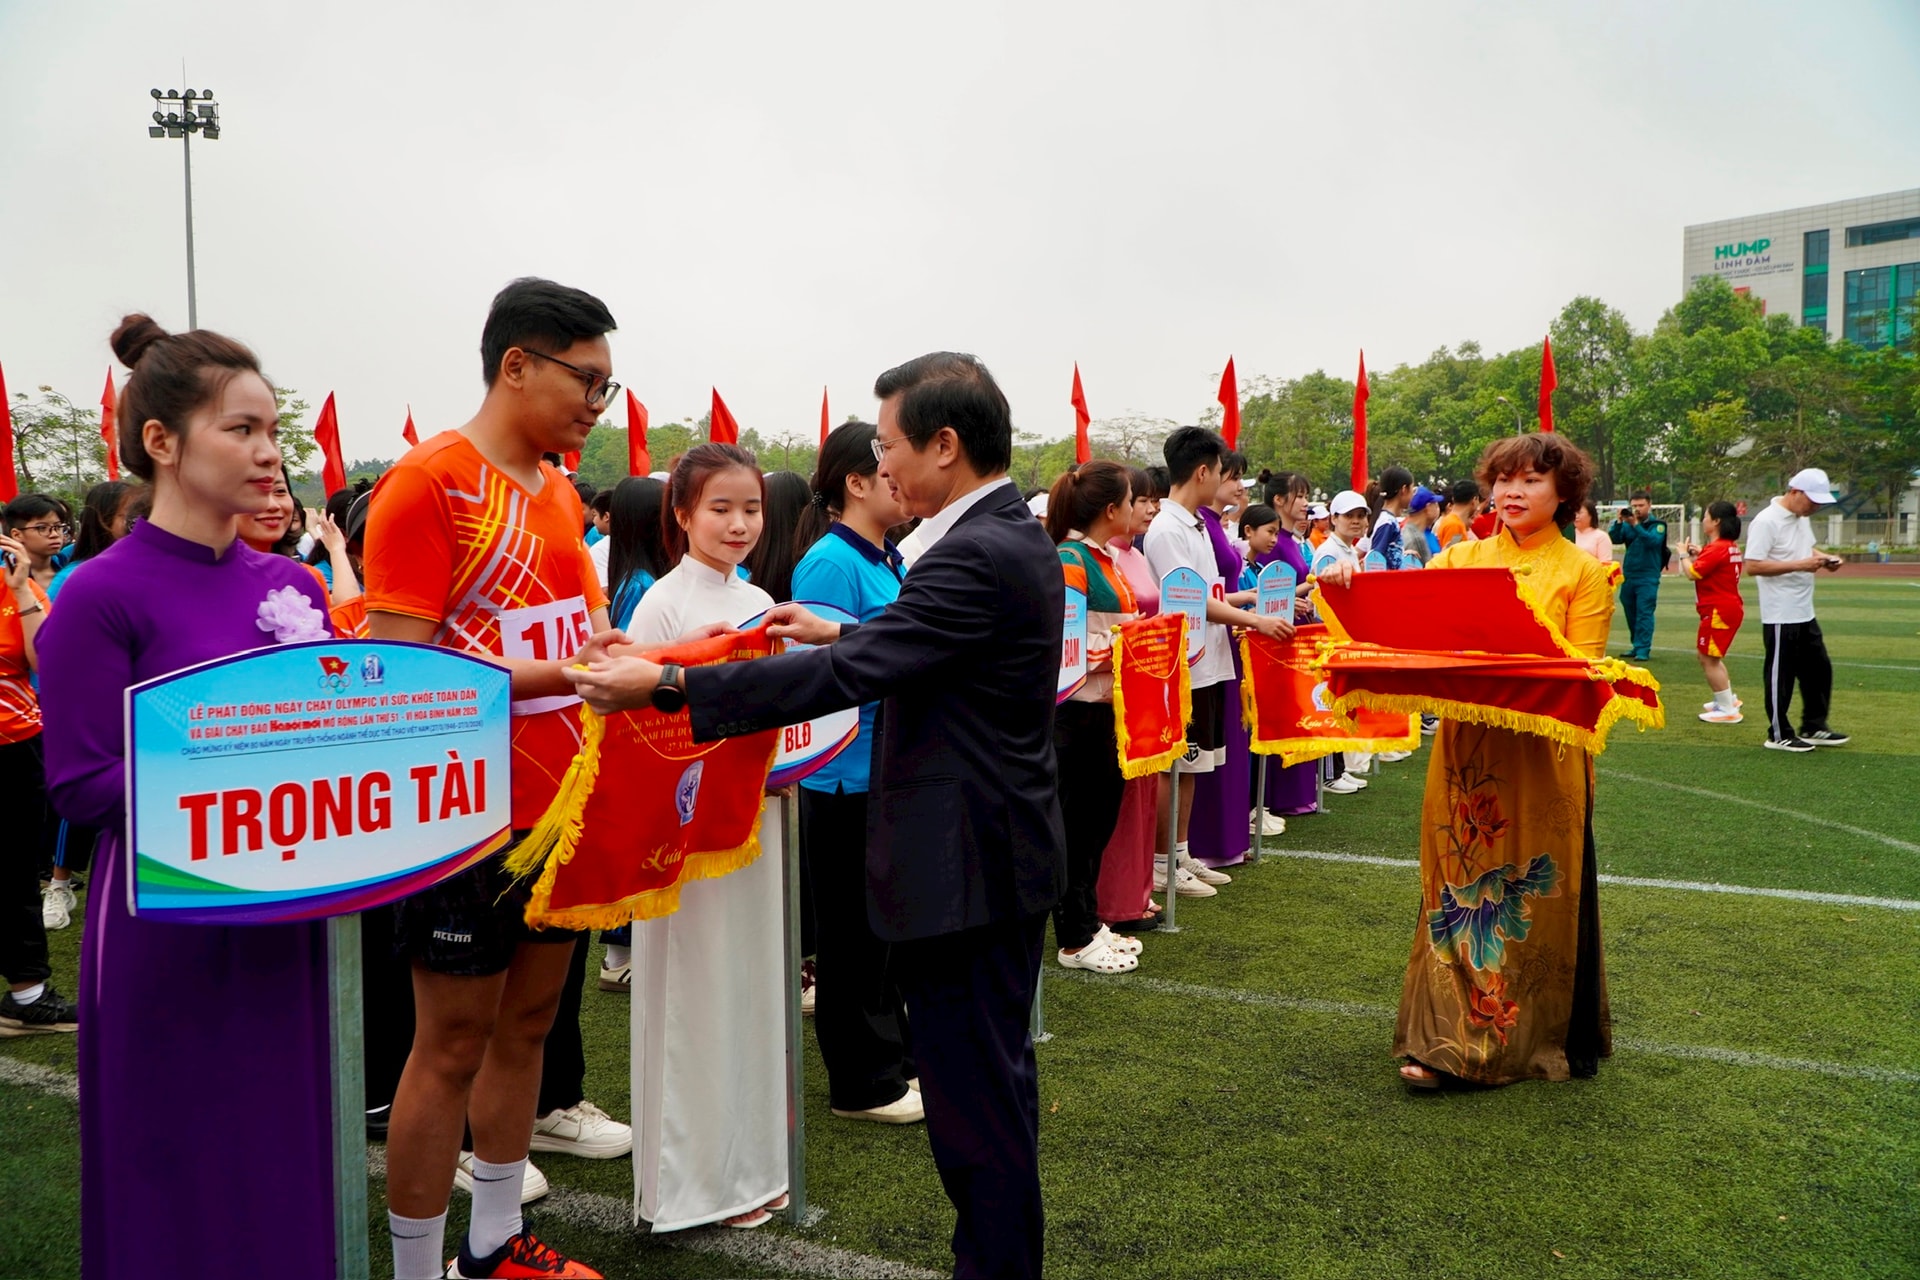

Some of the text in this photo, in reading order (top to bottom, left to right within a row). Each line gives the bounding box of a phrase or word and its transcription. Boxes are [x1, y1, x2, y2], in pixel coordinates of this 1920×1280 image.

[1714, 237, 1771, 260] HUMP
[1714, 259, 1742, 270] LINH
[189, 703, 203, 720] LỄ
[207, 704, 237, 719] PHÁT
[240, 702, 271, 718] ĐỘNG
[274, 700, 303, 714] NGÀY
[306, 699, 333, 714] CHẠY
[335, 696, 377, 710] OLYMPIC
[380, 694, 389, 706] VÌ
[391, 692, 409, 706] SỨC
[436, 689, 458, 702] TOÀN
[460, 687, 477, 700] DÂN
[390, 713, 399, 722] 51
[784, 720, 811, 754] BLĐ
[178, 750, 487, 862] TRỌNG TÀI
